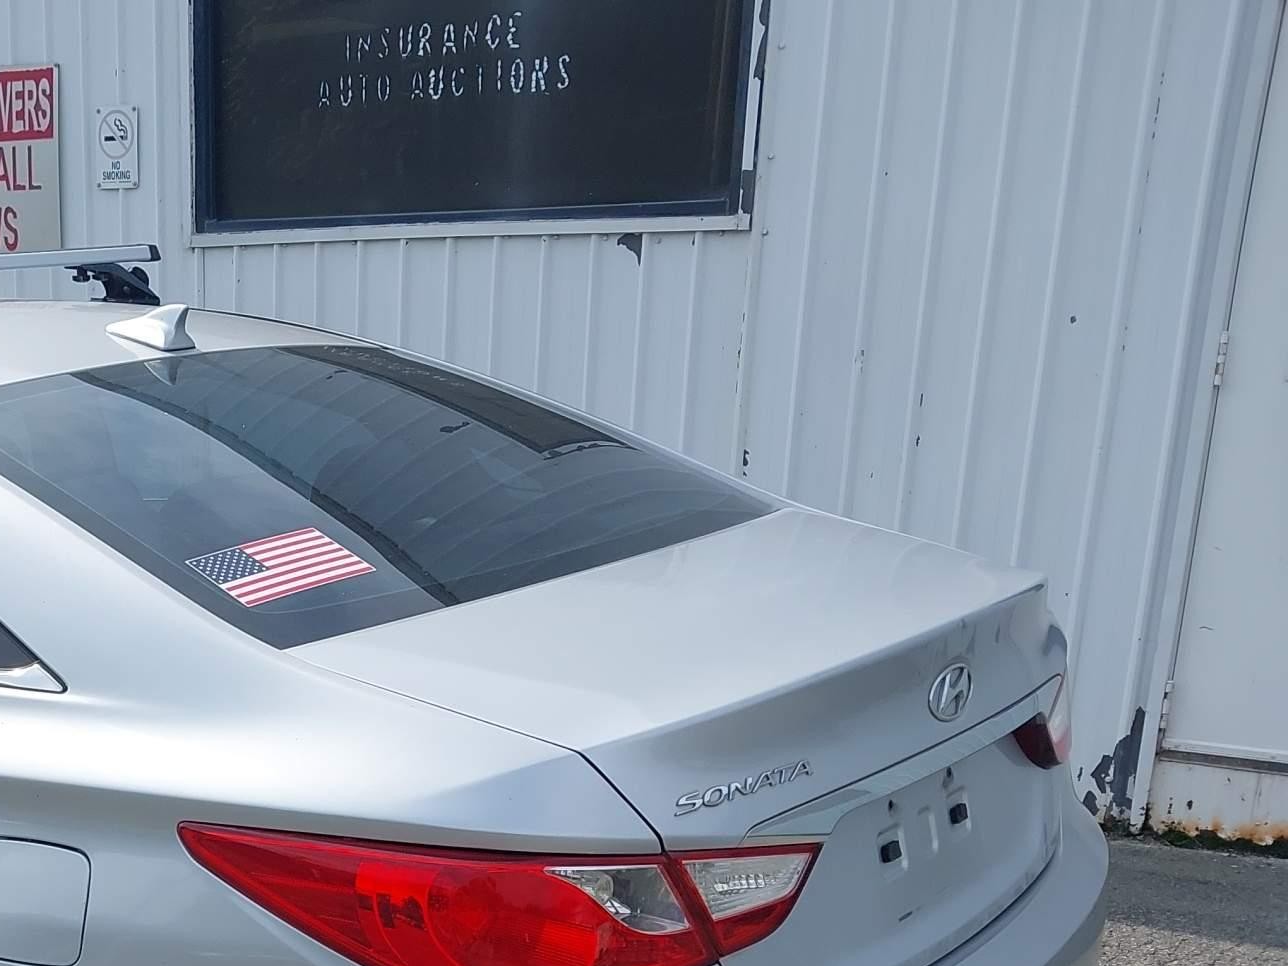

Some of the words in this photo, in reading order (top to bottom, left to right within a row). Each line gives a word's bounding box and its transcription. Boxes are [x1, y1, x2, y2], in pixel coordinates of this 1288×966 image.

[345, 11, 523, 63] INSURANCE
[318, 73, 391, 108] AUTO
[411, 54, 571, 100] AUCTIONS
[102, 170, 131, 180] SMOKING
[111, 160, 121, 170] NO
[673, 759, 814, 818] SONATA
